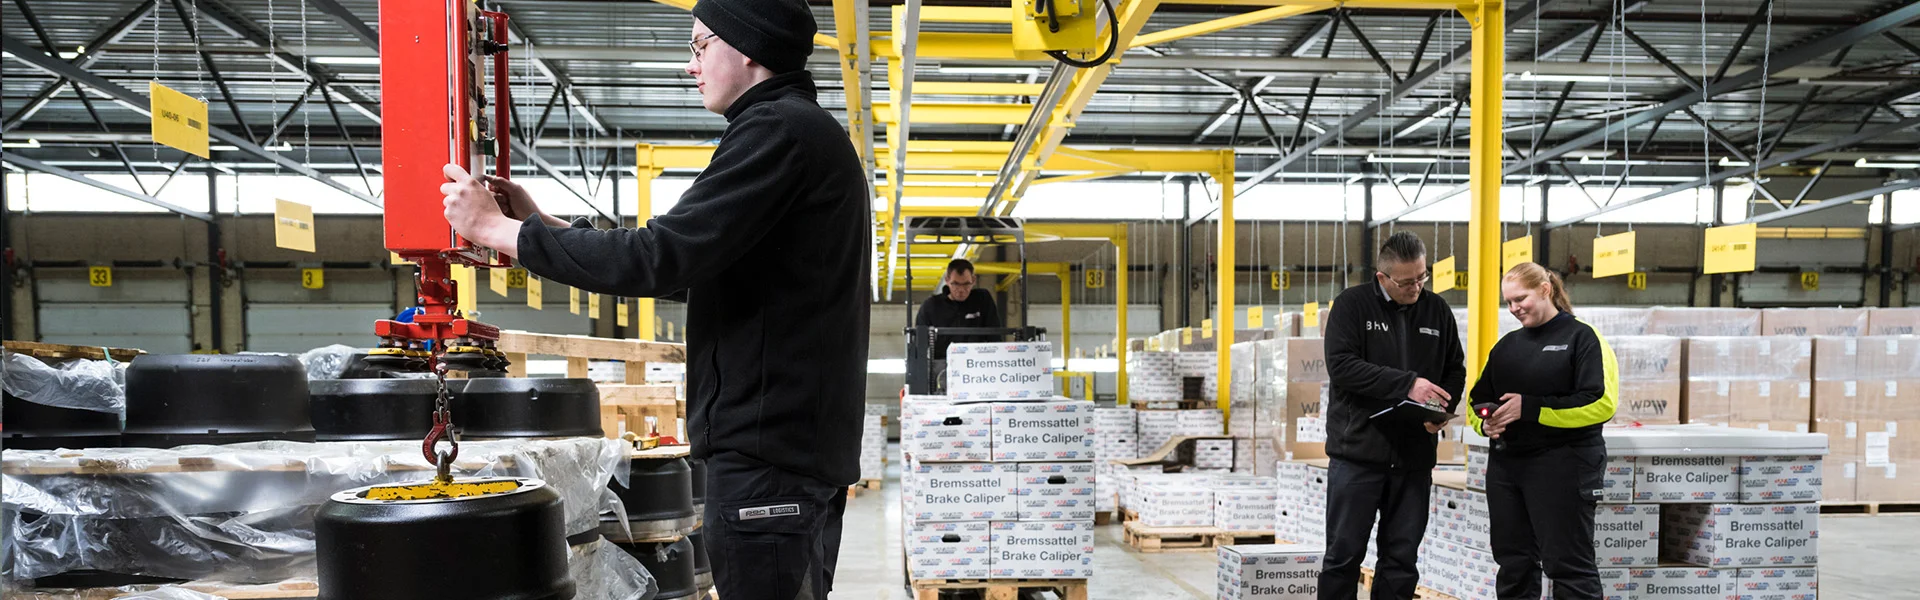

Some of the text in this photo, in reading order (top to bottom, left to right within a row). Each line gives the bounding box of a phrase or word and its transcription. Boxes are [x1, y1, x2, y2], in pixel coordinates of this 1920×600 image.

[93, 269, 107, 284] 33
[509, 271, 524, 286] 35
[1630, 275, 1644, 288] 41
[1803, 274, 1816, 288] 42
[966, 357, 1036, 368] Bremssattel
[1301, 359, 1325, 372] WP
[962, 372, 1041, 384] Brake Caliper
[1008, 417, 1079, 428] Bremssattel
[1004, 432, 1084, 445] Brake Caliper
[1651, 456, 1725, 466] Bremssattel
[930, 477, 1001, 488] Bremssattel
[1646, 472, 1729, 484] Brake Caliper
[925, 492, 1006, 505] Brake Caliper
[1256, 513, 1276, 521] Calip
[1594, 520, 1643, 531] mssattel
[1730, 520, 1803, 532] Bremssattel
[1007, 535, 1077, 546] Bremssattel
[1604, 537, 1648, 550] Caliper
[1725, 537, 1808, 549] Brake Caliper
[1002, 550, 1081, 562] Brake Caliper
[1256, 569, 1321, 579] Bremssatte
[1251, 583, 1317, 595] Brake Calip
[1646, 584, 1721, 594] Bremssattel
